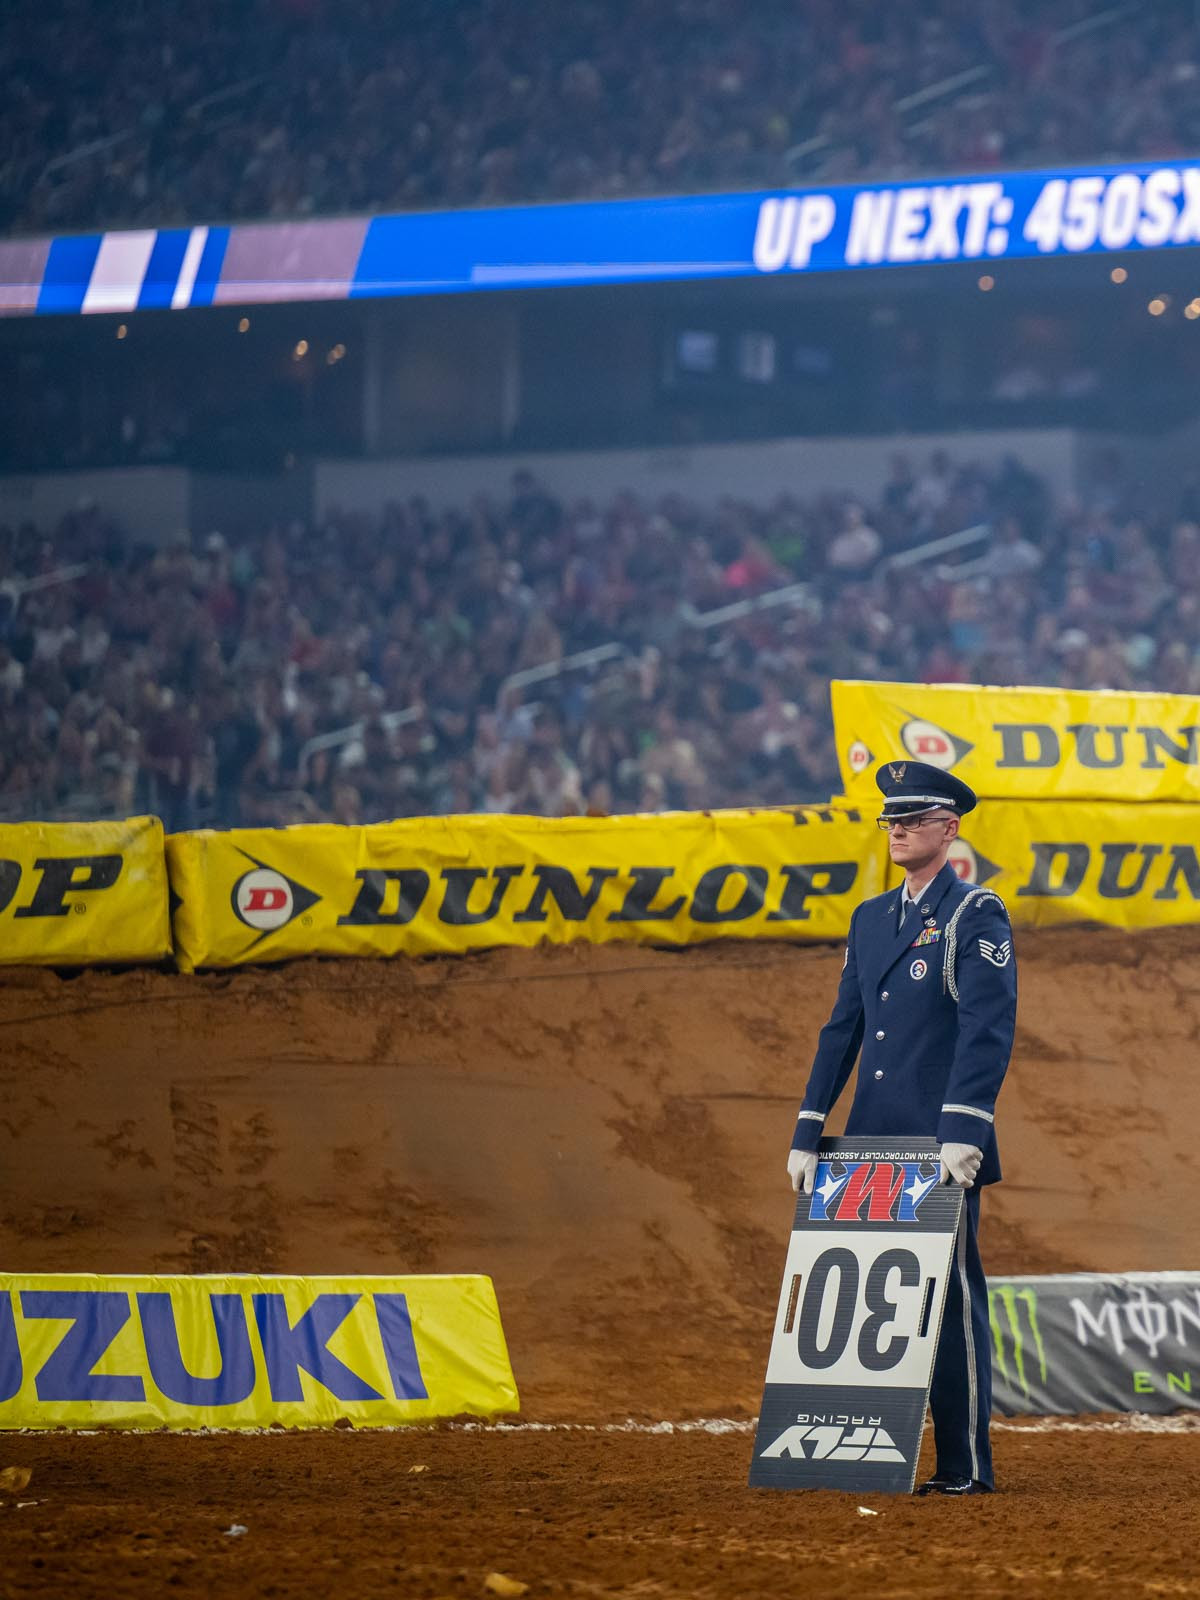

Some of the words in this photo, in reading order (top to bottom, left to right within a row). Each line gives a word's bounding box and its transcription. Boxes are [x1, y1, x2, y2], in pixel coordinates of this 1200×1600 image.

[753, 195, 835, 272] UP
[845, 181, 1013, 265] NEXT:
[336, 861, 858, 926] DUNLOP
[860, 1152, 918, 1160] MOTORCYCLIST
[919, 1152, 941, 1161] RICAN
[809, 1162, 941, 1221] AMA
[797, 1247, 920, 1371] 30
[0, 1290, 428, 1406] ZUKI
[759, 1425, 907, 1463] FLY
[796, 1413, 882, 1425] RACING
